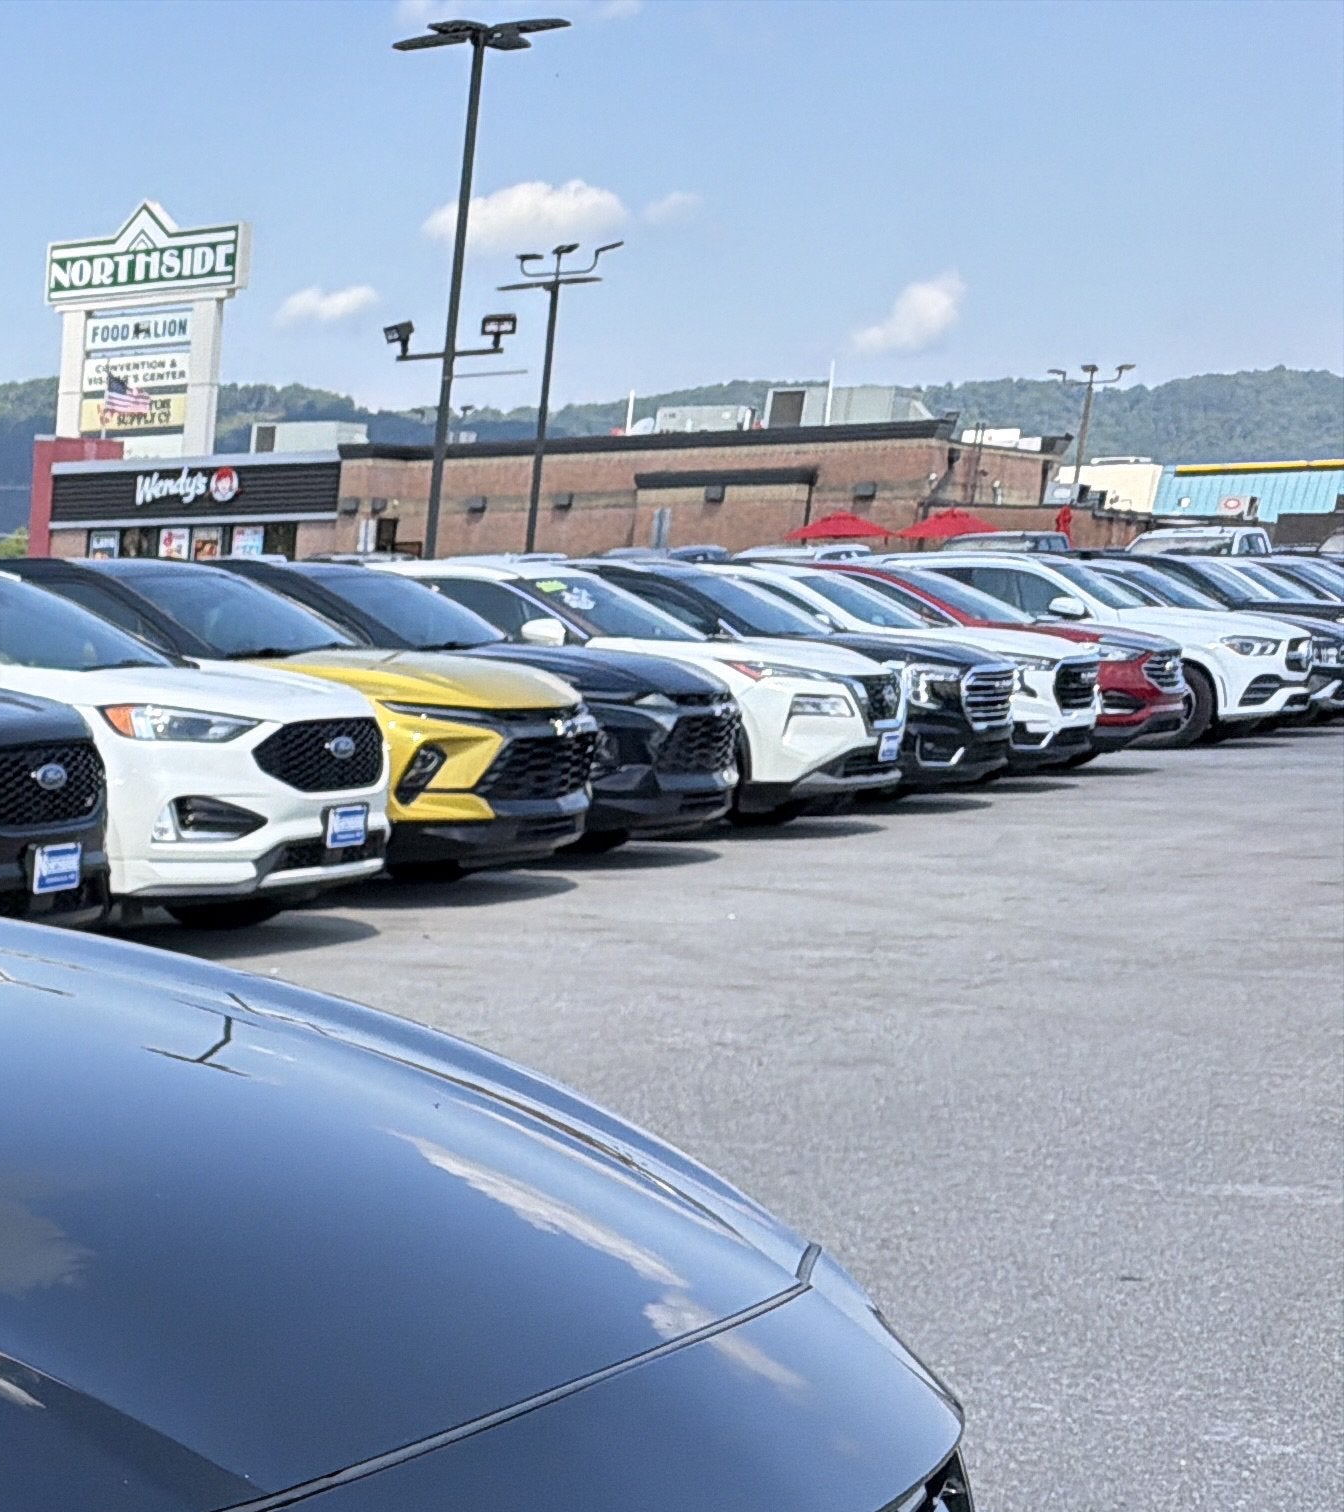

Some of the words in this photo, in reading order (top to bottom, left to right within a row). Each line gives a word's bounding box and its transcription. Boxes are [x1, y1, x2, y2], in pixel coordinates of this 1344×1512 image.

[50, 243, 235, 289] NORTHSIDE
[91, 323, 130, 343] FOOD
[153, 318, 188, 338] LION
[142, 370, 186, 382] CENTER
[135, 463, 209, 507] Wendy's
